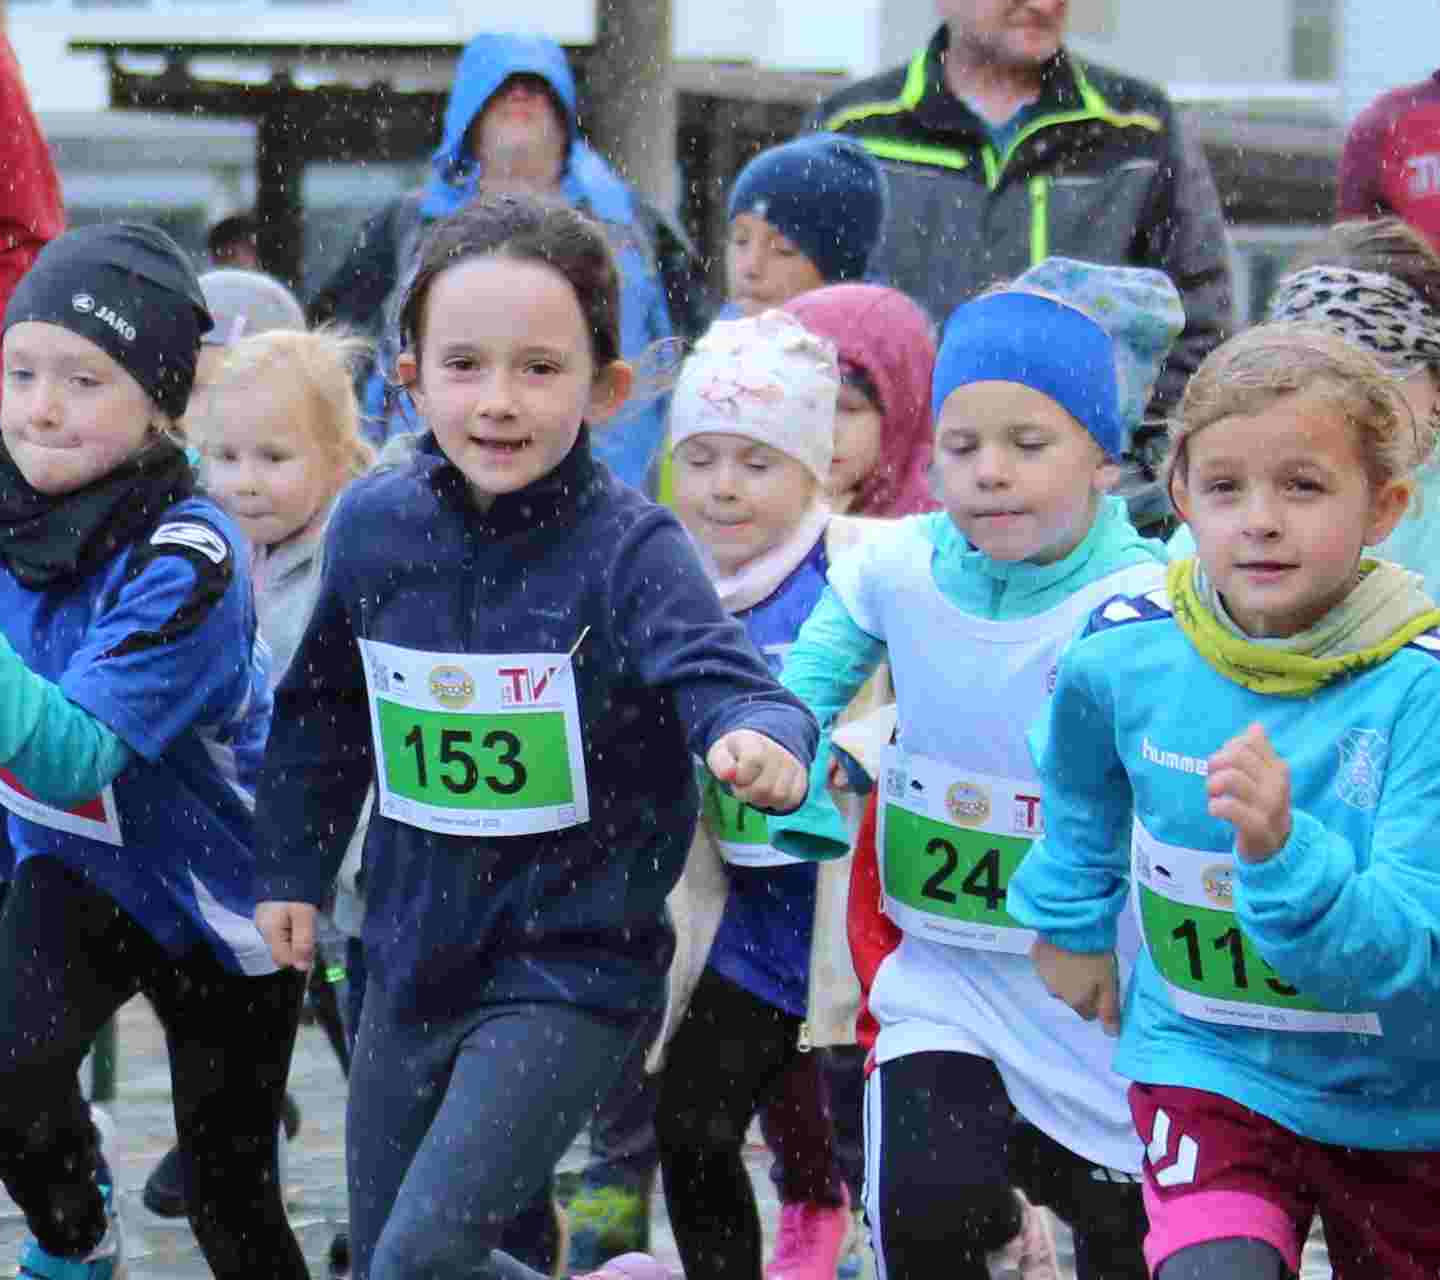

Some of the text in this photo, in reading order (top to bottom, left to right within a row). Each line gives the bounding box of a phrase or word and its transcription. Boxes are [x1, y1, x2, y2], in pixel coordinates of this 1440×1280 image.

[94, 305, 137, 341] JAKO
[404, 724, 528, 795] 153
[1142, 735, 1209, 777] humme
[1171, 918, 1301, 998] 11
